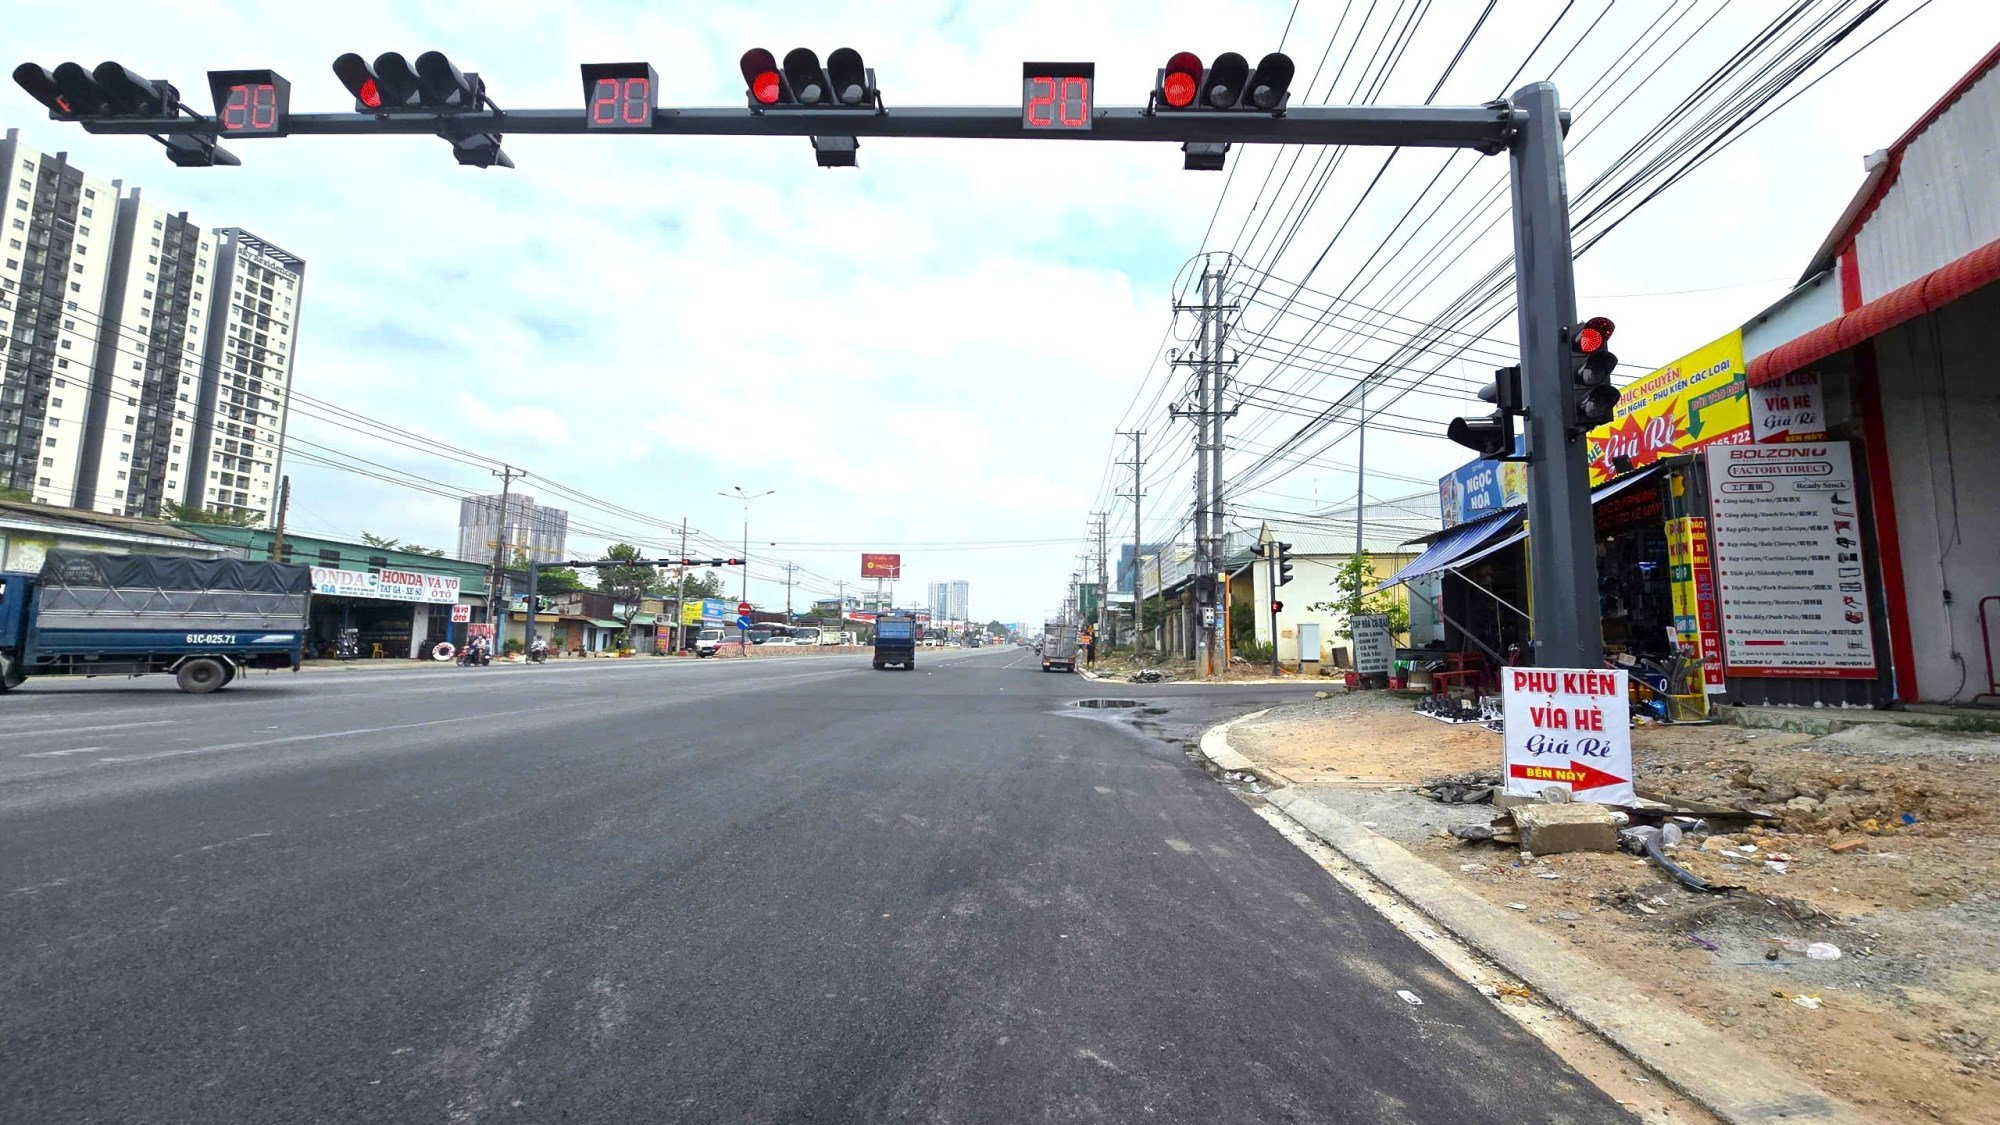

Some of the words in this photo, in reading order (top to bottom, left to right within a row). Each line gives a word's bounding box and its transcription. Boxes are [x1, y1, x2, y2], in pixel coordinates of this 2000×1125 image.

[224, 84, 276, 129] 20
[592, 78, 649, 124] 20
[1028, 76, 1087, 126] 20
[1627, 398, 1647, 413] NGHE
[1690, 369, 1707, 385] CÁC
[1708, 359, 1730, 377] LOẠI
[1644, 413, 1677, 450] Rẻ
[1730, 448, 1810, 460] BOLZONI
[1732, 465, 1783, 475] FACTORY
[1785, 464, 1828, 473] DIRECT
[1467, 469, 1492, 495] NGỌC
[1796, 482, 1821, 490] Ready
[1823, 481, 1847, 489] Stock
[1670, 542, 1688, 557] KN
[310, 567, 367, 587] ONDA
[381, 570, 424, 587] HONDA
[321, 584, 336, 594] GA
[186, 634, 236, 644] 61C-025.71
[1513, 671, 1557, 698] PHỤ
[1563, 669, 1616, 700] KIỆN
[1530, 701, 1568, 730] VỈA
[1574, 705, 1603, 732] HÈ
[1525, 734, 1570, 757] Giá
[1576, 737, 1612, 758] Rẻ
[1526, 766, 1552, 778] BÊN
[1555, 768, 1587, 781] NÀY
